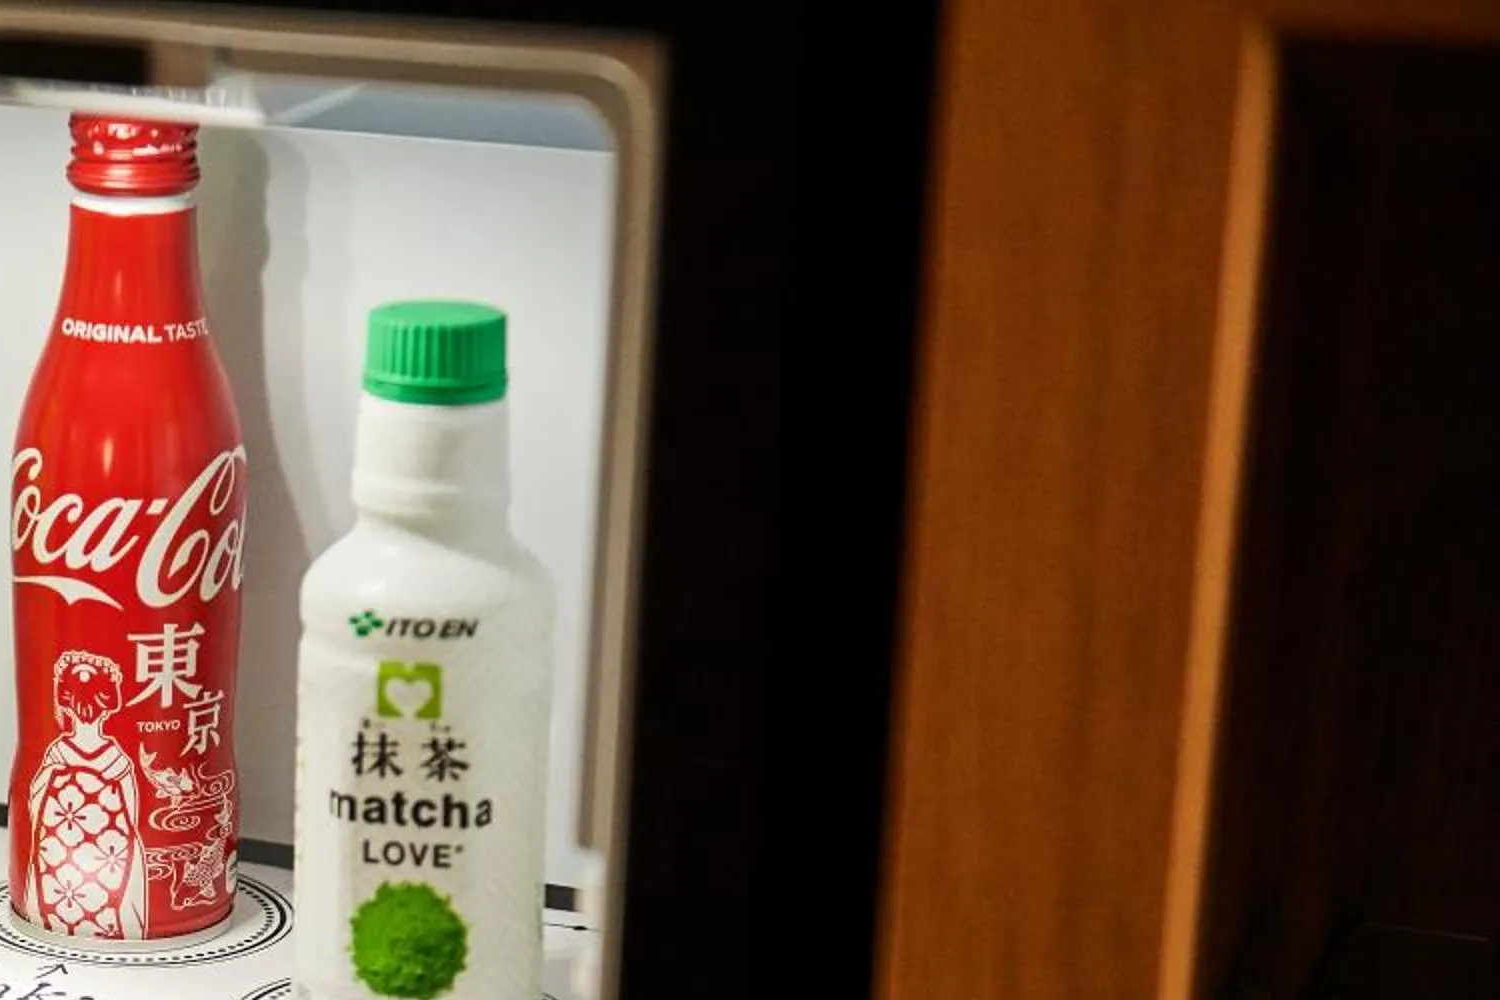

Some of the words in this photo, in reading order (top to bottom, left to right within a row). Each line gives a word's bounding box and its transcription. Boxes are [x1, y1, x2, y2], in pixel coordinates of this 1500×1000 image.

[62, 317, 162, 343] ORIGINAL
[385, 618, 434, 639] ITO
[438, 618, 480, 639] EN
[126, 623, 224, 756] 東京
[136, 719, 181, 733] TOKYO
[350, 731, 470, 782] 抹茶
[328, 789, 493, 829] matcha
[362, 840, 453, 868] LOVE
